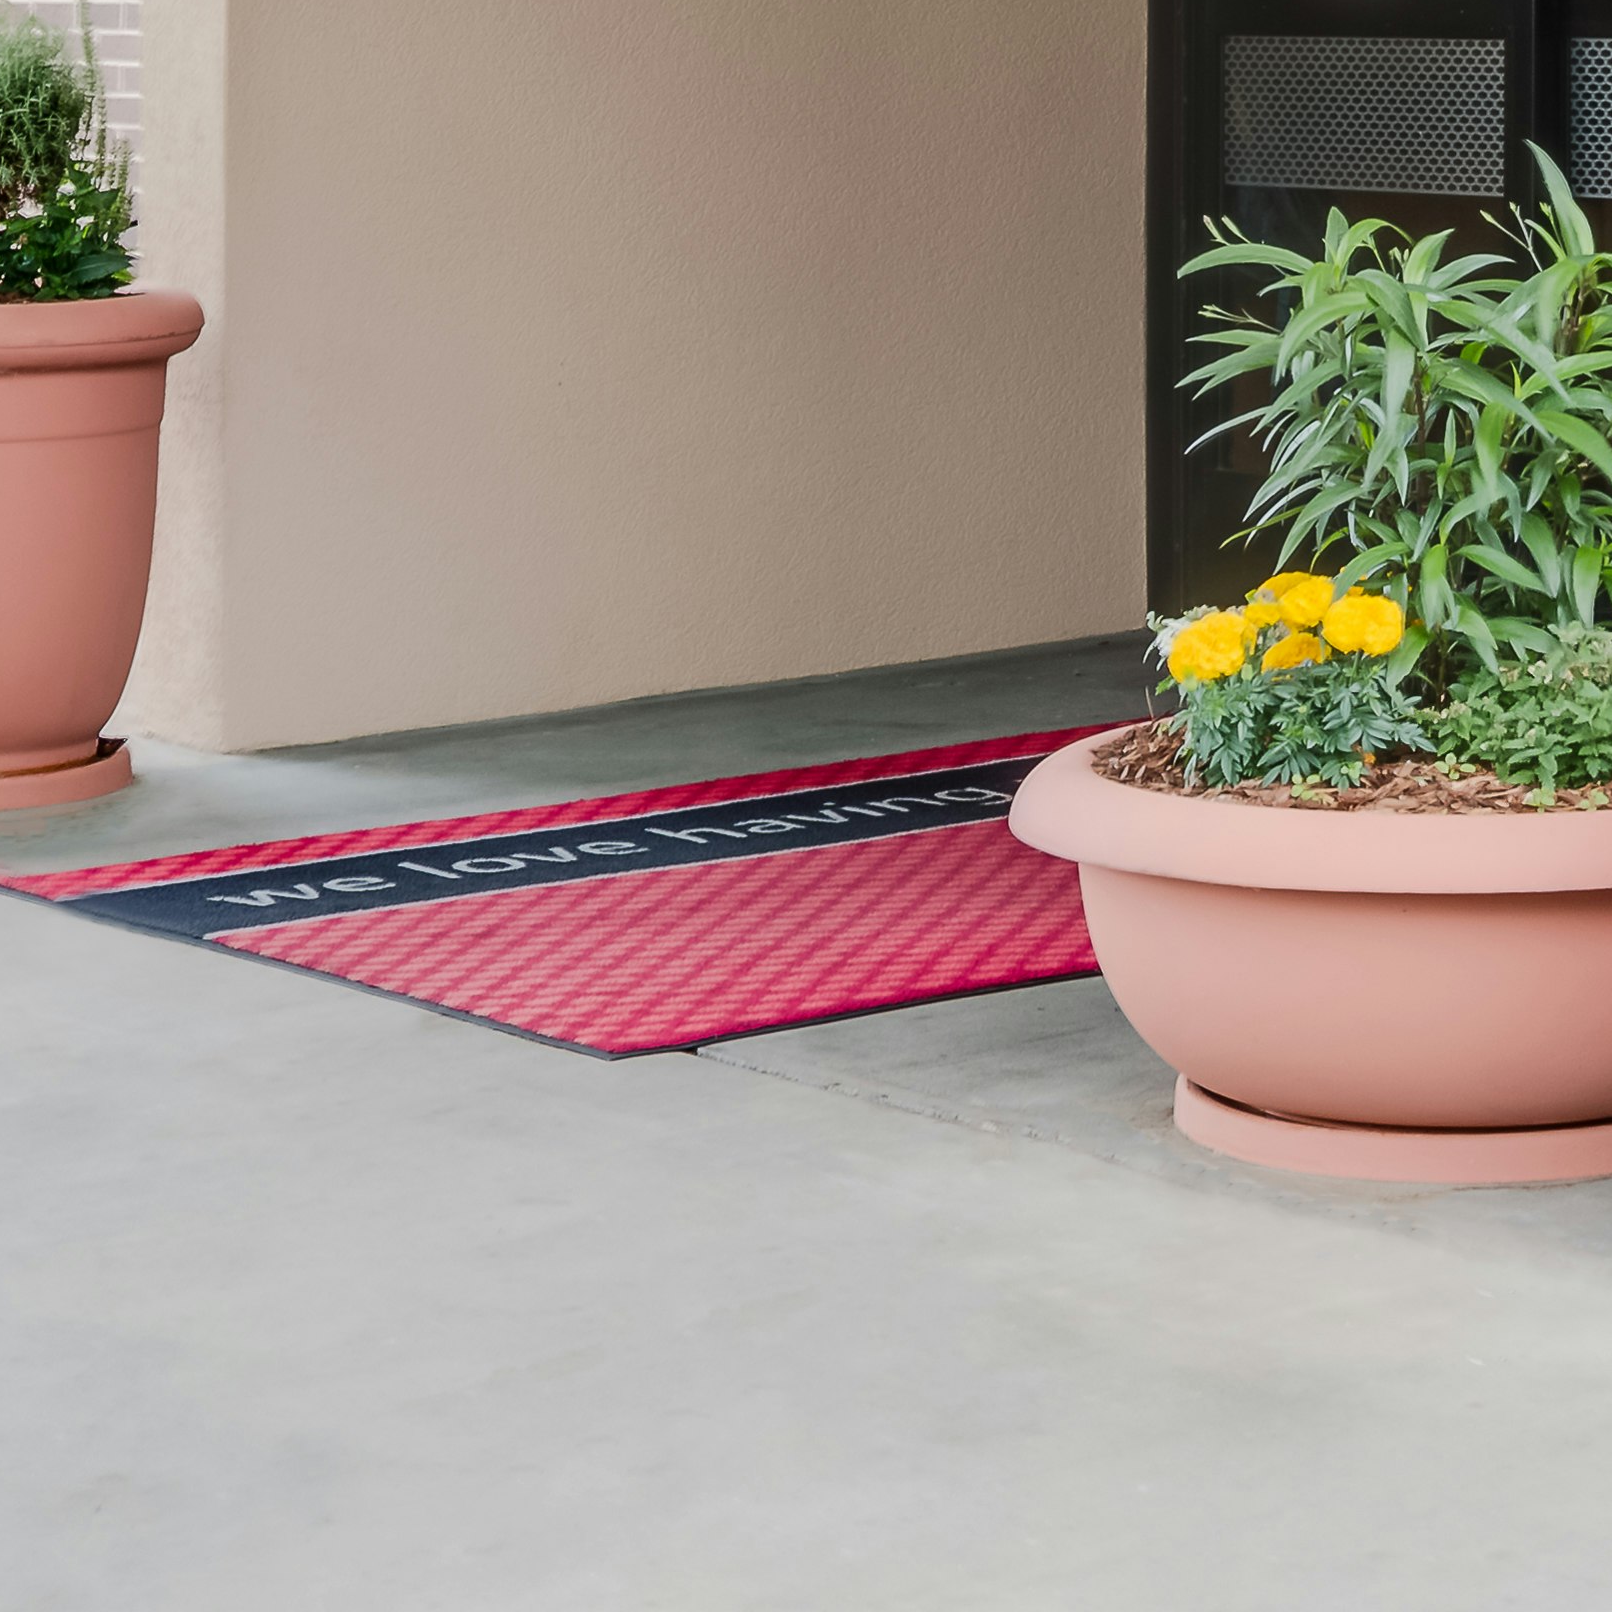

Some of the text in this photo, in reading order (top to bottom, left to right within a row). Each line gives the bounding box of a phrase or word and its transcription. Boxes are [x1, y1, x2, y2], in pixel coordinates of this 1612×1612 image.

[207, 786, 1013, 907] we love having
